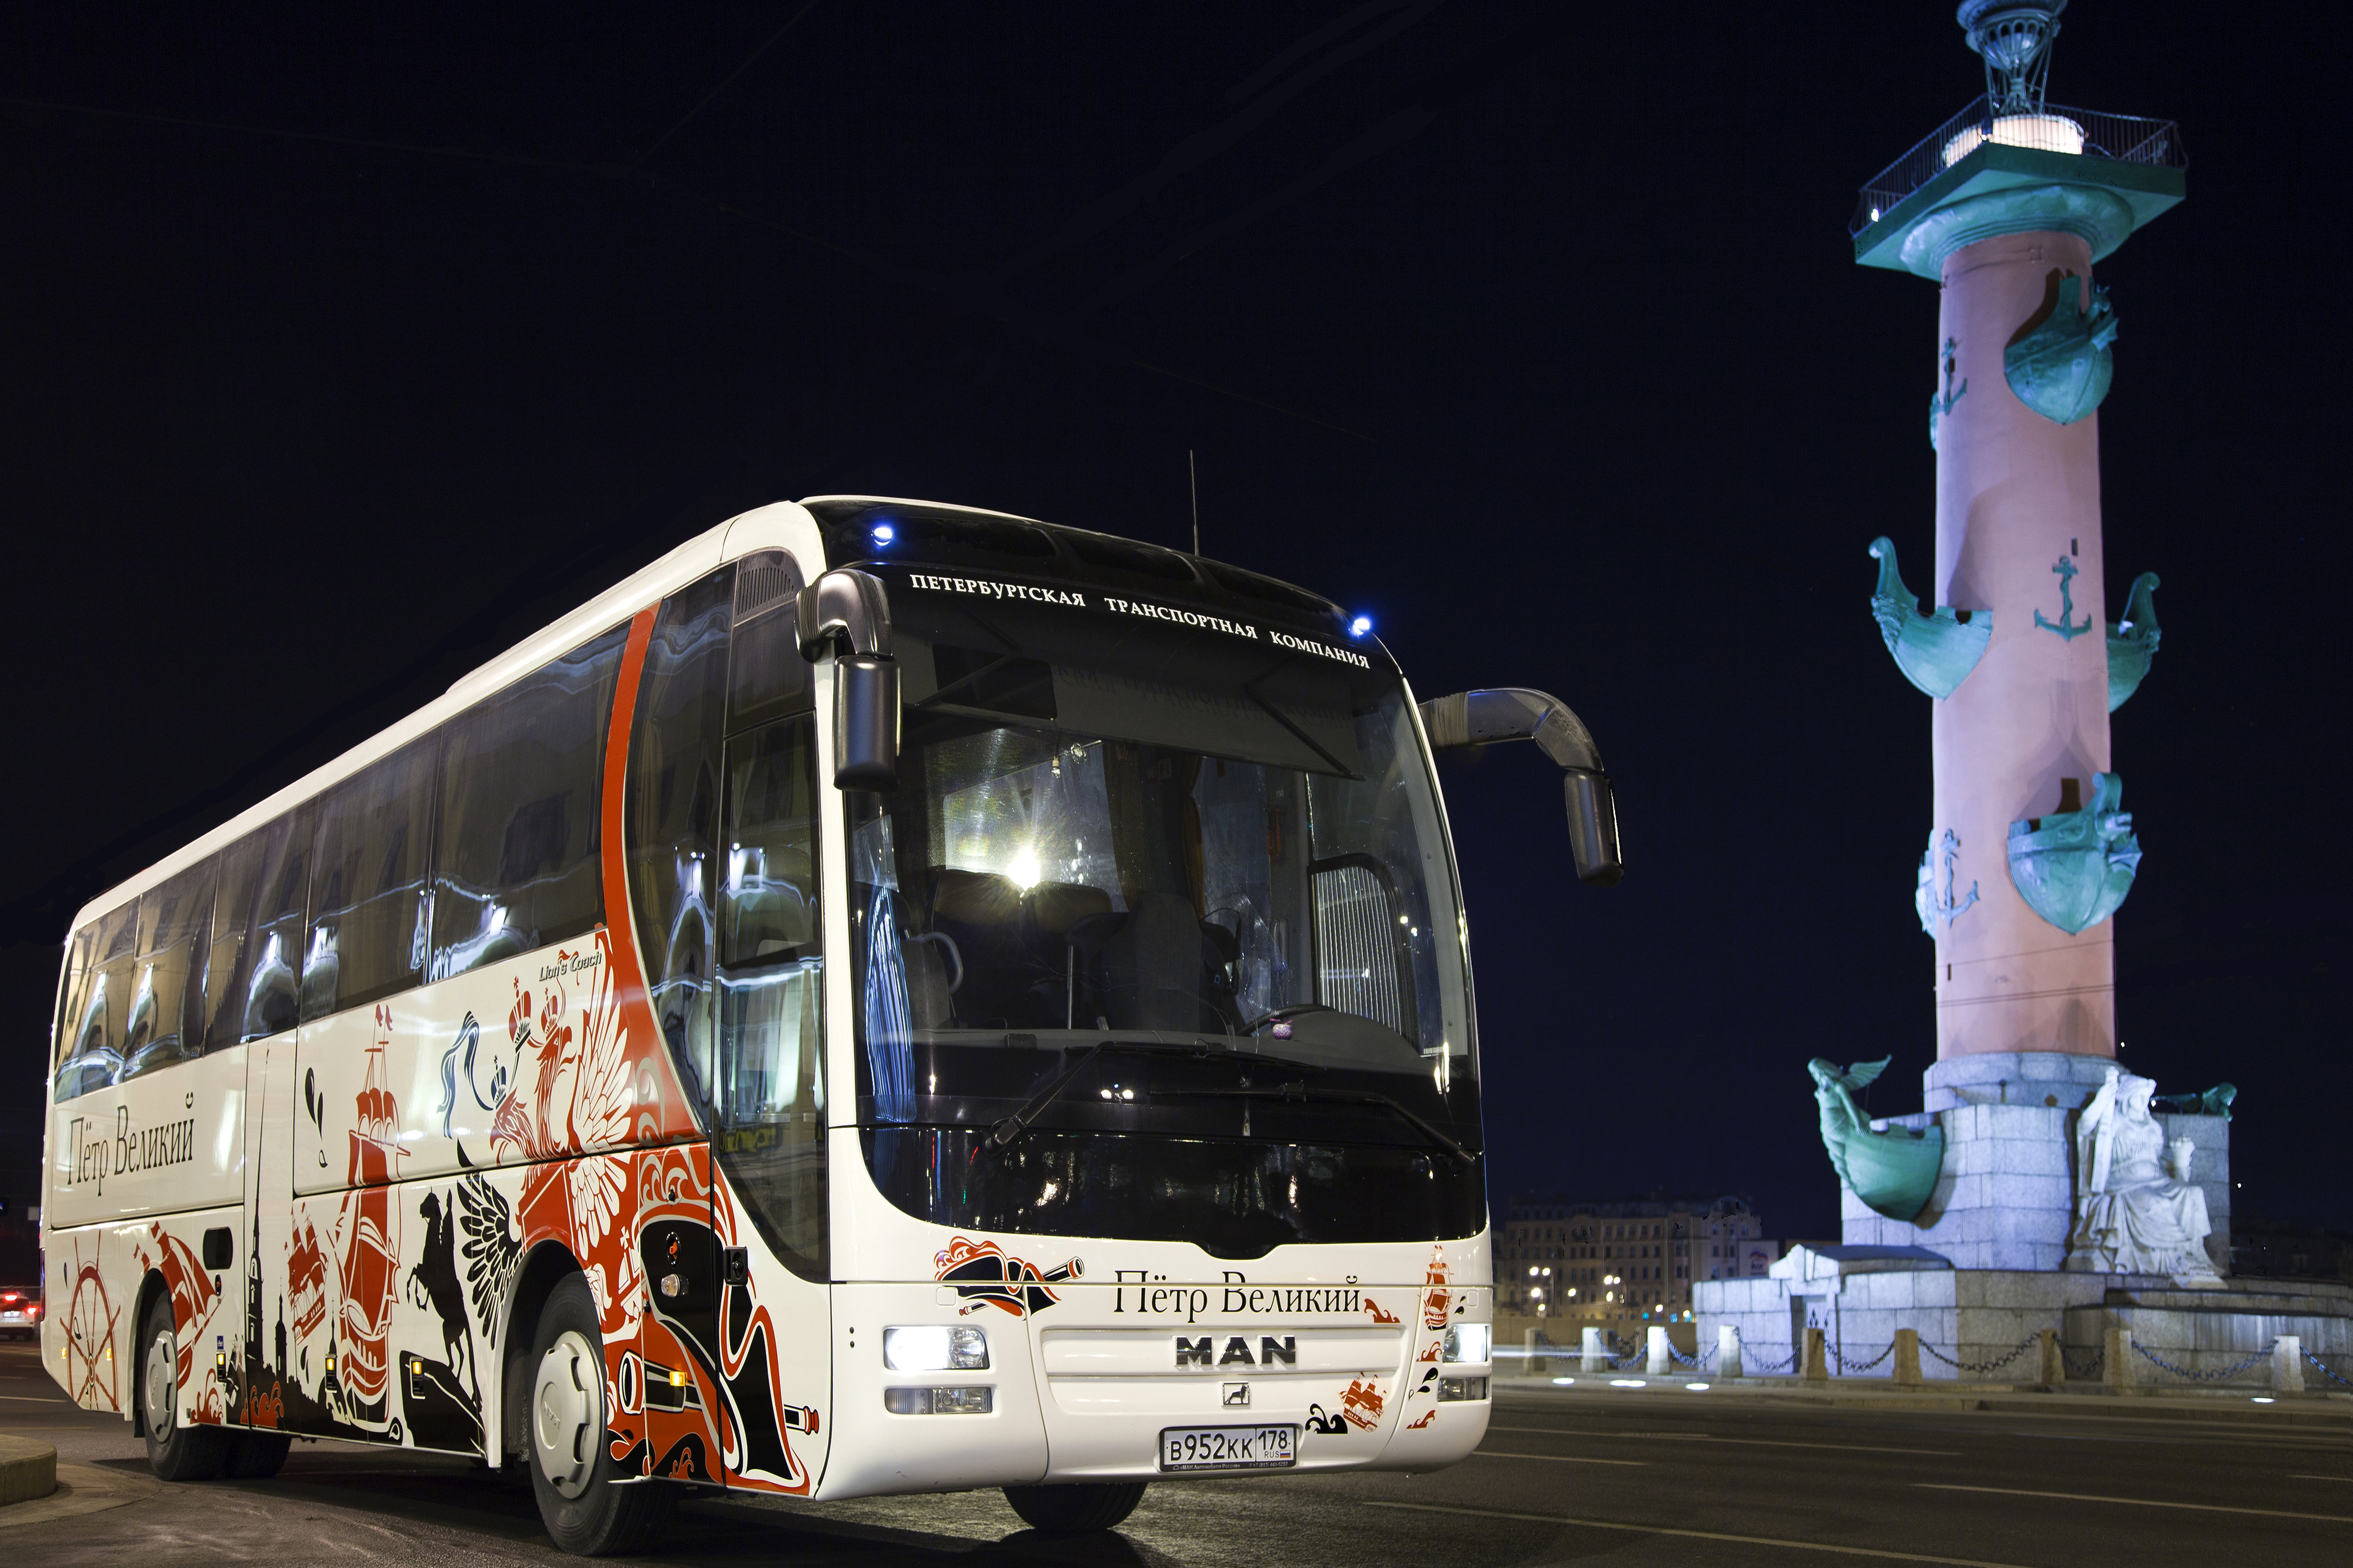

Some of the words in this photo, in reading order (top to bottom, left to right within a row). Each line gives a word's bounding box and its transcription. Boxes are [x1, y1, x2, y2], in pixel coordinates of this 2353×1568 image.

[909, 574, 1086, 607] ПЕТЕРБУРГСКАЯ
[1104, 597, 1258, 639] ТРАНСПОРТНАЯ
[1270, 631, 1371, 669] КОМПАНИЯ
[539, 959, 567, 982] Lion's
[570, 952, 602, 972] Coach
[68, 1116, 108, 1196] Пётр
[114, 1092, 194, 1175] Великий
[1114, 1270, 1208, 1323] Пётр
[1221, 1271, 1361, 1313] Великий
[1175, 1335, 1297, 1366] MAN
[1258, 1430, 1288, 1450] 178
